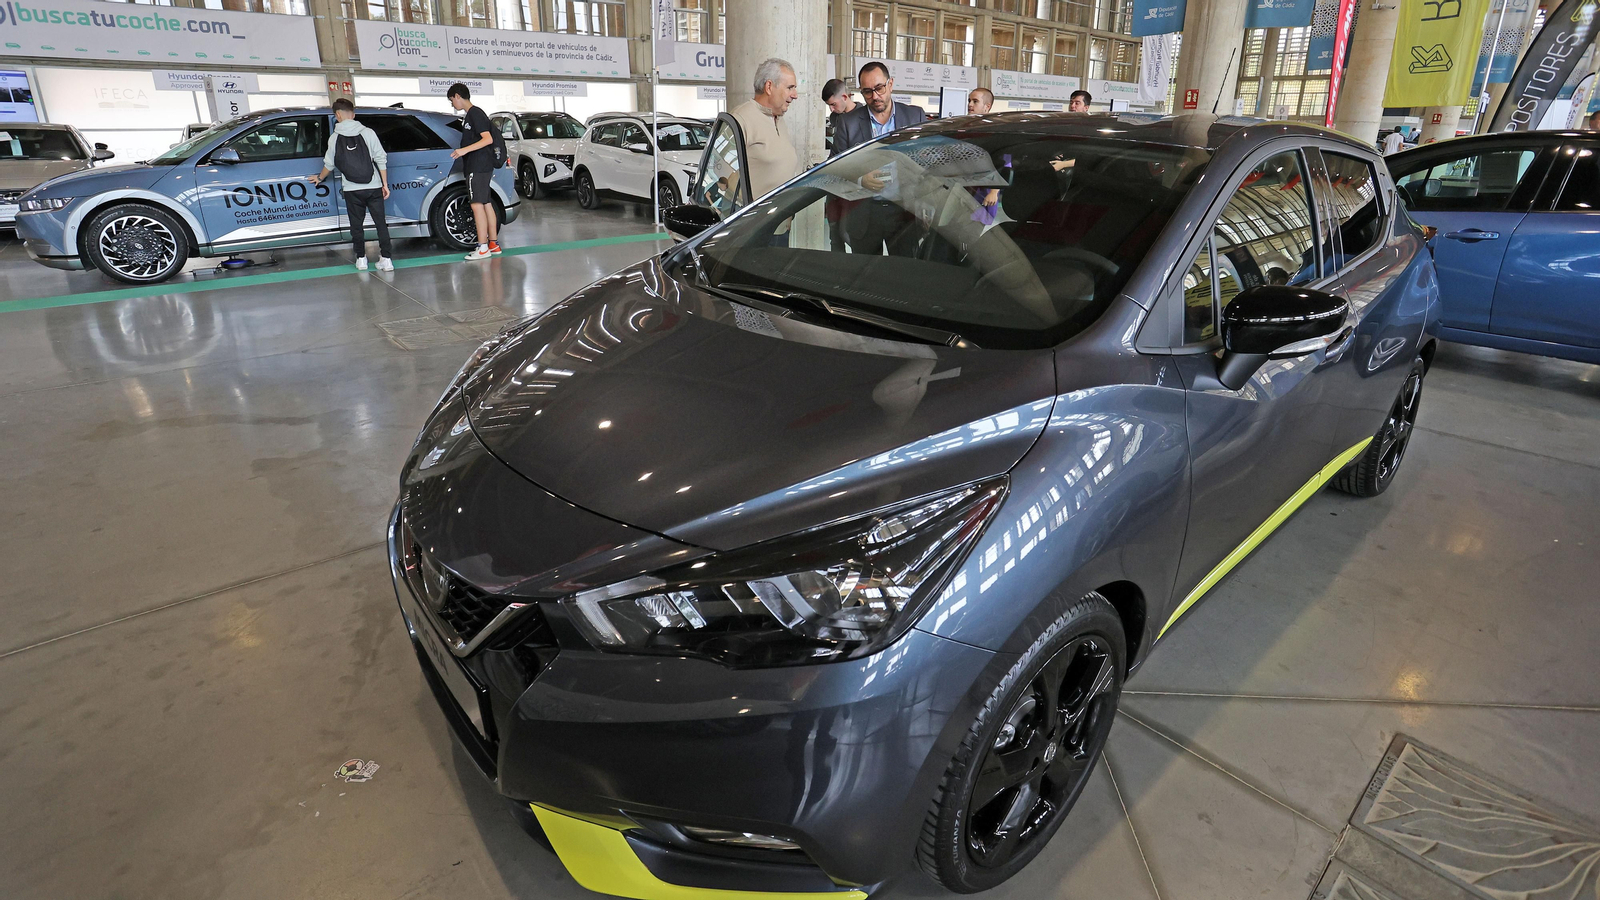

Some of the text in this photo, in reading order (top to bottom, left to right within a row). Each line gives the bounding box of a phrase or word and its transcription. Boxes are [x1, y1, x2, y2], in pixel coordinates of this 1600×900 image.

[397, 27, 426, 40] busca
[398, 37, 441, 49] tucoche.
[454, 36, 598, 52] Descubre el mayor portal de vehículos de
[454, 45, 483, 55] ocasión
[485, 49, 490, 57] y
[492, 48, 534, 58] seminuevos
[535, 50, 544, 58] de
[545, 50, 553, 59] la
[554, 51, 585, 62] provincia
[585, 52, 594, 61] de
[695, 50, 725, 68] Gru
[167, 72, 206, 82] Hyundai
[429, 79, 457, 87] Hyundai
[170, 82, 203, 90] Approved
[93, 87, 149, 100] IFECA
[391, 181, 425, 191] MOTOR
[221, 181, 309, 209] IONIQ
[234, 209, 262, 218] Coche
[263, 203, 297, 215] Mundial
[312, 200, 328, 208] Año
[236, 217, 258, 225] Hasta
[257, 213, 285, 222] 646km
